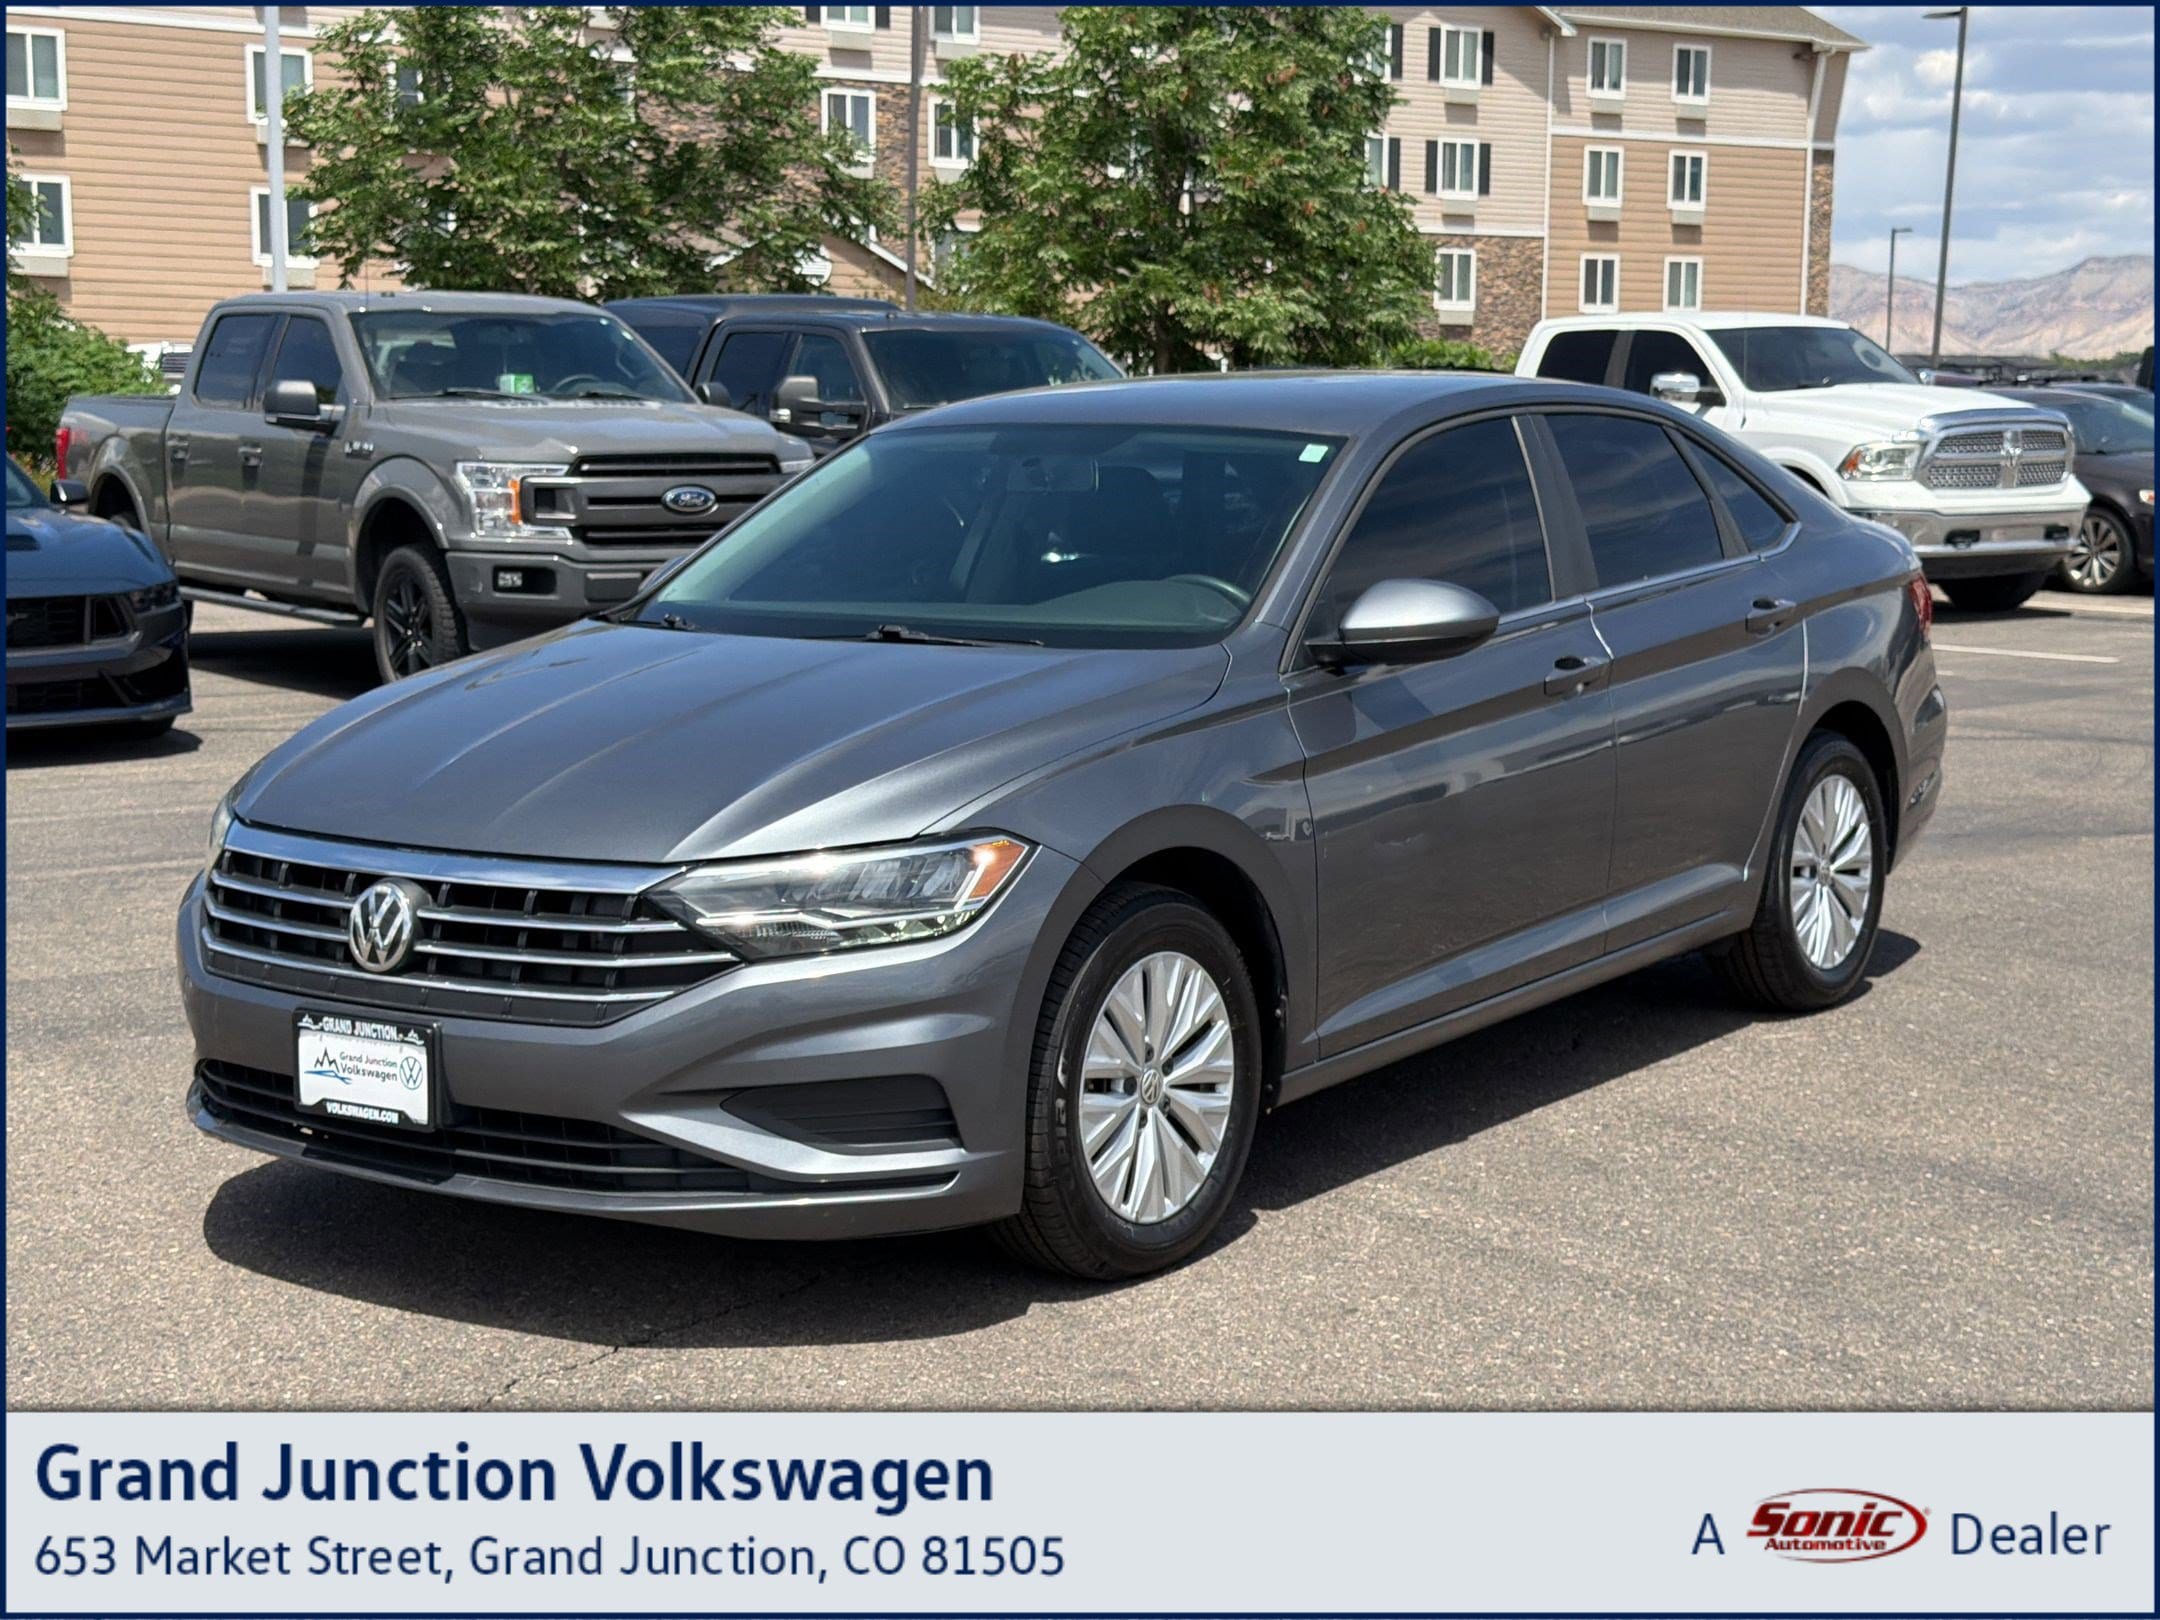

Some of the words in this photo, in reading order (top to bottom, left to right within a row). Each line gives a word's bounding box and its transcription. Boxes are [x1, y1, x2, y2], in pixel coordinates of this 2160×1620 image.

[322, 1016, 352, 1034] GRAND
[354, 1020, 398, 1041] JUNCTION
[339, 1051, 362, 1064] Grand
[364, 1055, 398, 1068] Junction
[340, 1063, 398, 1083] Volkswagen
[326, 1102, 399, 1125] VOLKSWAGEN.COM
